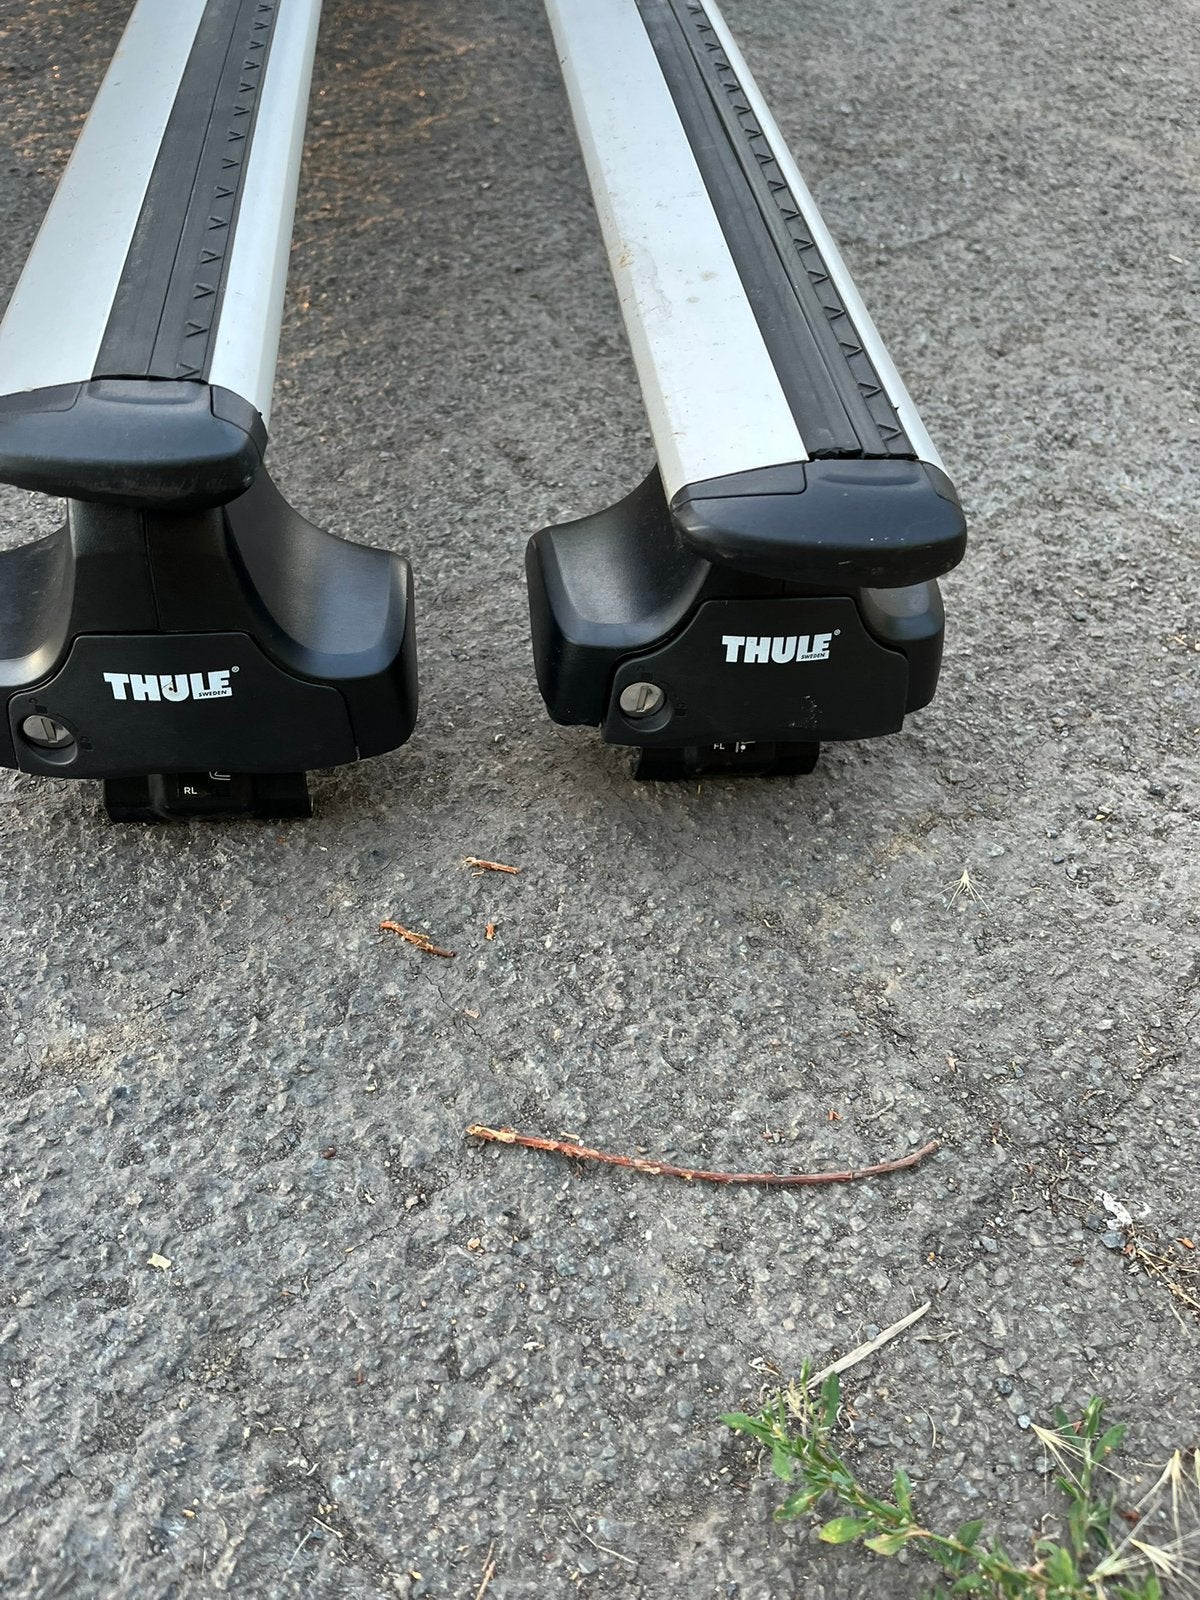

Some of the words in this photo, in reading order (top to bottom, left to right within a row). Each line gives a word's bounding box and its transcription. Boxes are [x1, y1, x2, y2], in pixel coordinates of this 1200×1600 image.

[801, 652, 826, 660] SWEDEN
[198, 689, 228, 698] SWEDEN
[183, 786, 198, 795] RL
